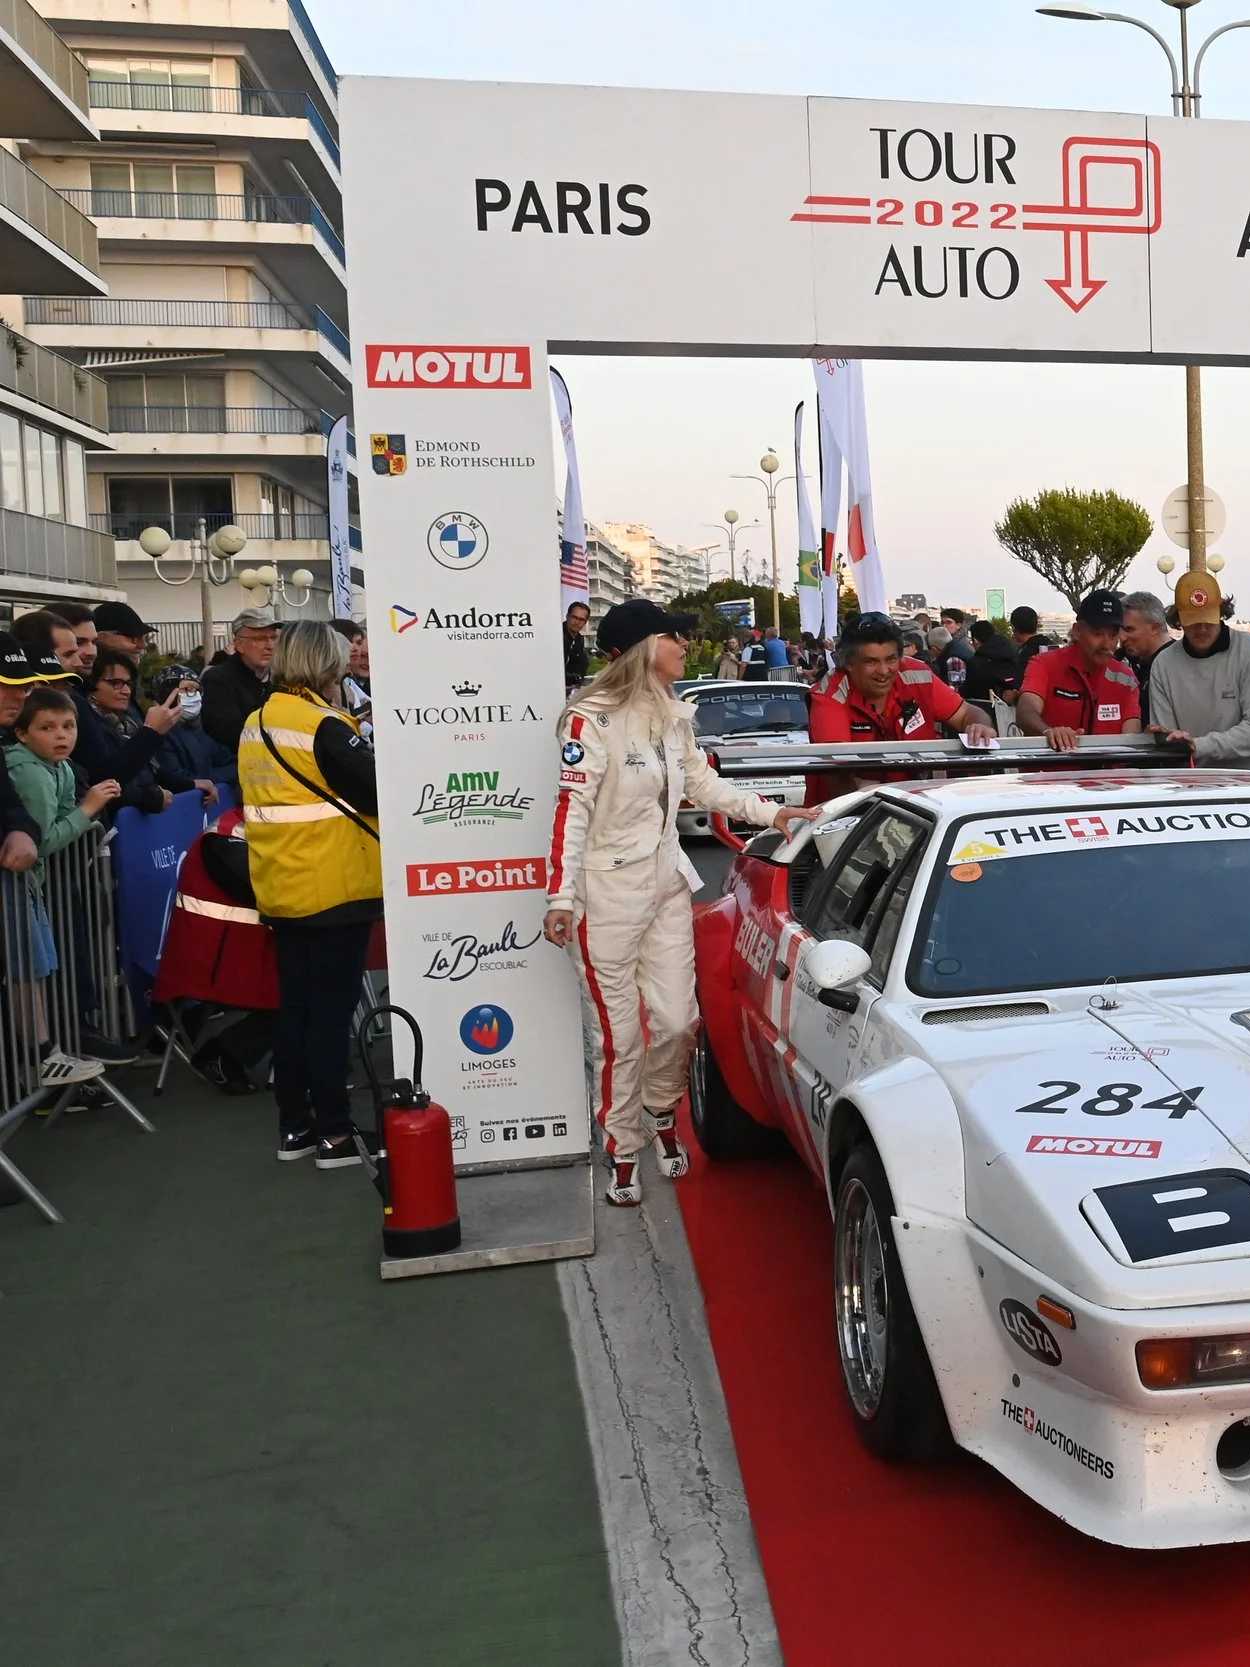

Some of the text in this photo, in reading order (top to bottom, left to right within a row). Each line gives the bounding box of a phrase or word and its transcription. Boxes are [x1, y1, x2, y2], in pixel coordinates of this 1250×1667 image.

[869, 127, 1016, 184] TOUR
[475, 178, 651, 236] PARIS
[876, 197, 1017, 230] 2022
[875, 243, 1020, 300] AUTO
[375, 351, 524, 383] MOTUL
[415, 440, 481, 452] EDMOND
[440, 456, 535, 468] ROTHSCHILD
[435, 514, 479, 531] BMW
[423, 607, 533, 629] Andorra
[447, 630, 534, 641] visitandorra.com
[696, 693, 801, 704] PORSCHE
[393, 704, 543, 726] VICOMTE A.
[454, 733, 486, 742] PARIS
[562, 771, 585, 782] OTUL
[454, 819, 496, 828] ASSURANCE
[985, 822, 1066, 848] THE
[151, 848, 170, 869] VILLE
[971, 843, 984, 855] 5
[418, 862, 537, 891] Le Point
[422, 932, 453, 942] VILLE DE
[449, 920, 541, 981] Baule
[735, 917, 776, 980] BULER
[480, 959, 528, 971] ESCOUBLAC
[461, 1058, 517, 1072] LIMOGES
[1015, 1080, 1205, 1119] 284
[1036, 1138, 1154, 1156] MOTUL
[1002, 1306, 1059, 1359] LISTA
[1001, 1399, 1115, 1480] THE AUCTIONEERS
